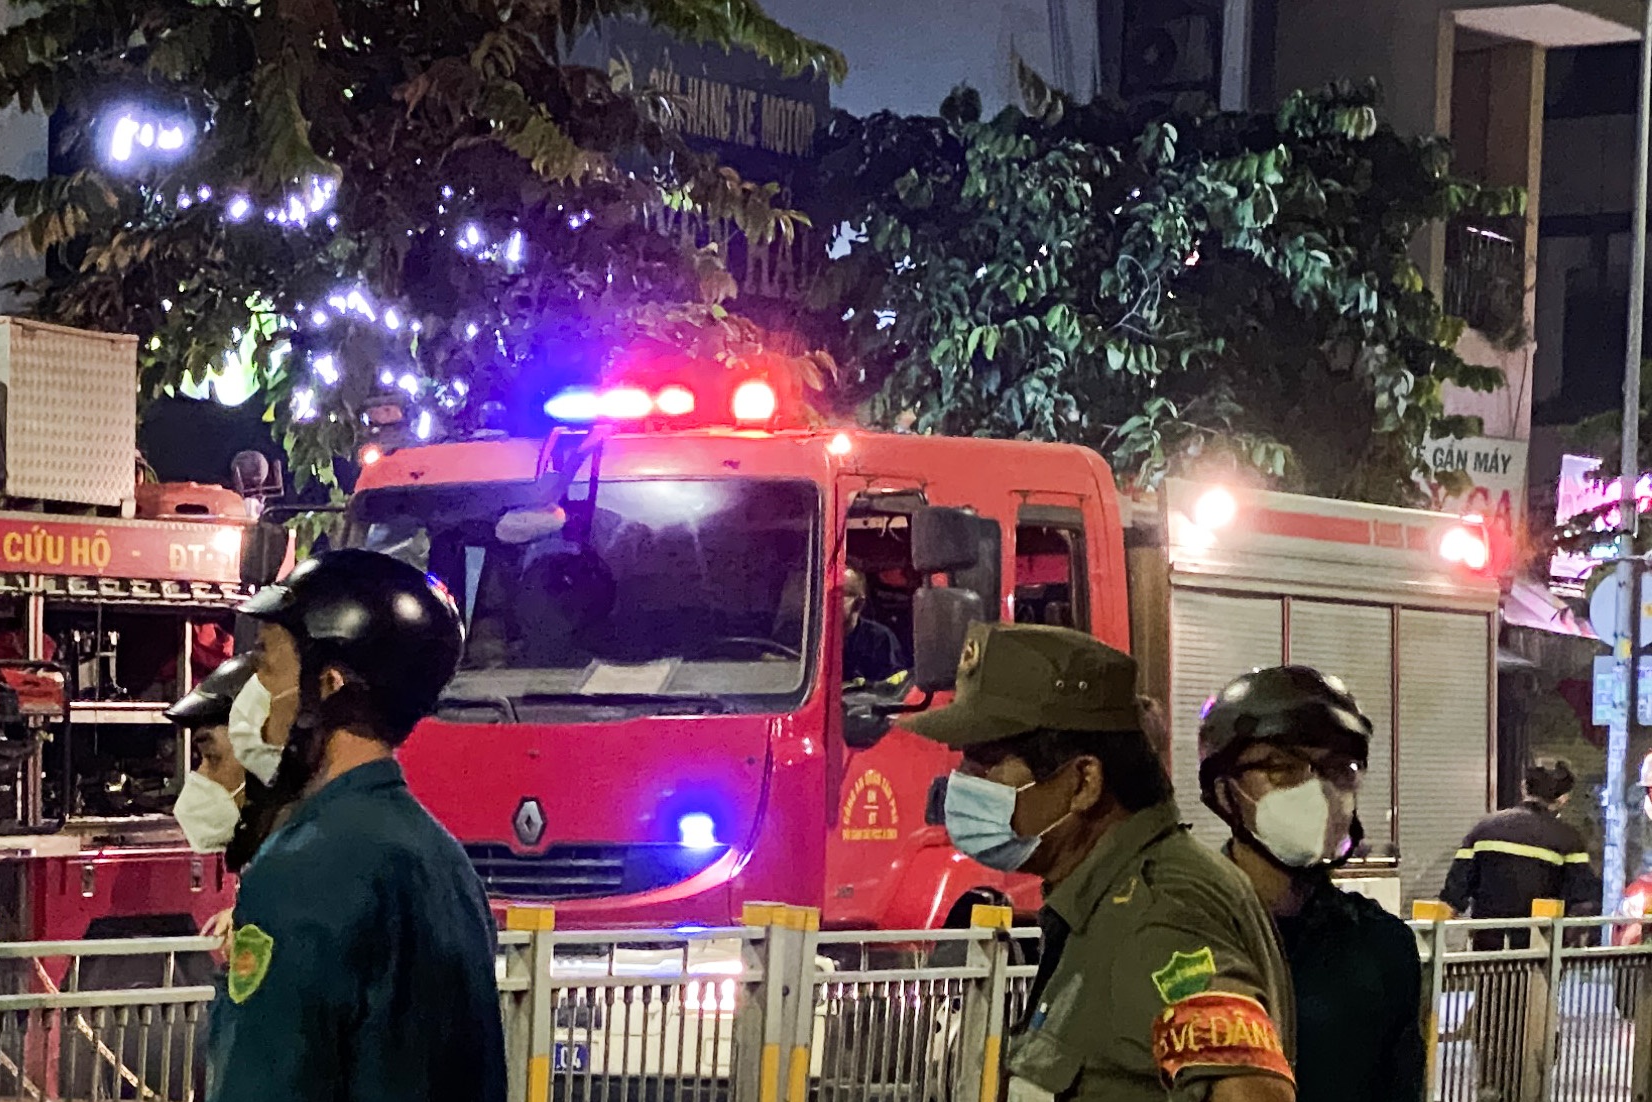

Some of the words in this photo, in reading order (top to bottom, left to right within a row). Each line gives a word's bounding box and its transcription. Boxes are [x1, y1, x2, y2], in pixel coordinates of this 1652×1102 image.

[734, 86, 758, 147] XE
[1473, 447, 1512, 475] MÁY
[3, 524, 65, 567] CỨU
[71, 529, 112, 574] HỘ
